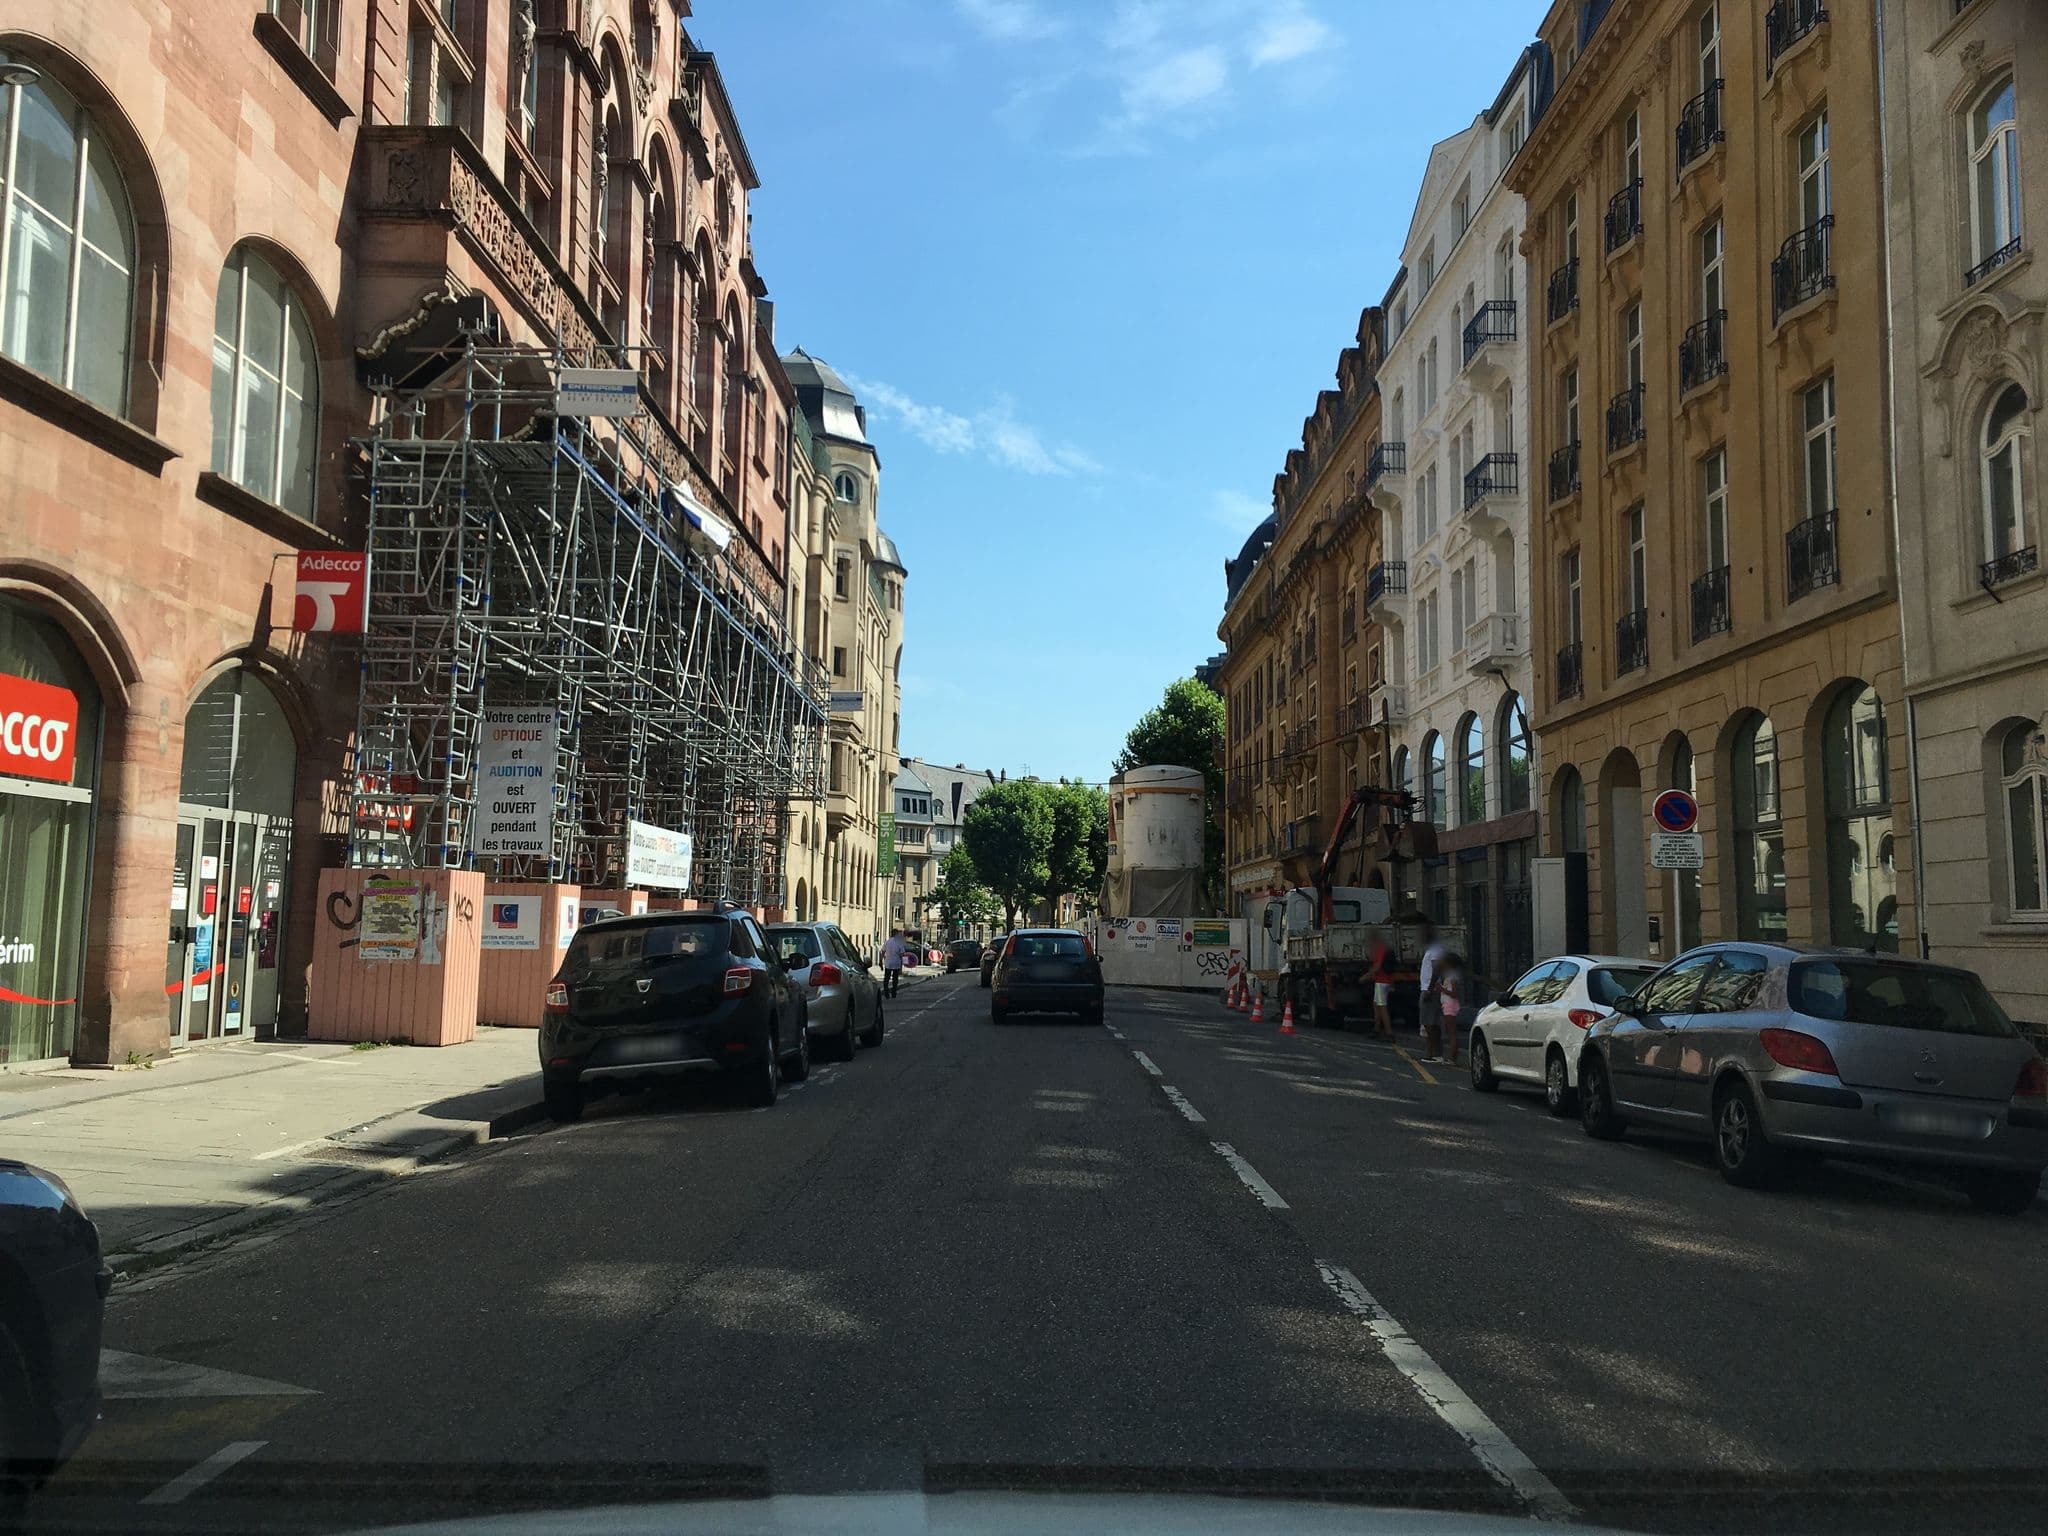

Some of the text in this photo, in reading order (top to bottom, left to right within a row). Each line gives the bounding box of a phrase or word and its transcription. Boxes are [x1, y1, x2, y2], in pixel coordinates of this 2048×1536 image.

[302, 556, 362, 571] Adecco
[486, 712, 552, 723] Votre centre
[493, 729, 542, 741] OPTIQUE
[512, 748, 523, 759] et
[489, 766, 543, 777] AUDITION
[507, 784, 525, 795] est
[493, 802, 536, 814] OUVERT
[491, 821, 536, 834] pendant
[880, 815, 893, 838] ibis
[482, 839, 544, 850] les travaux
